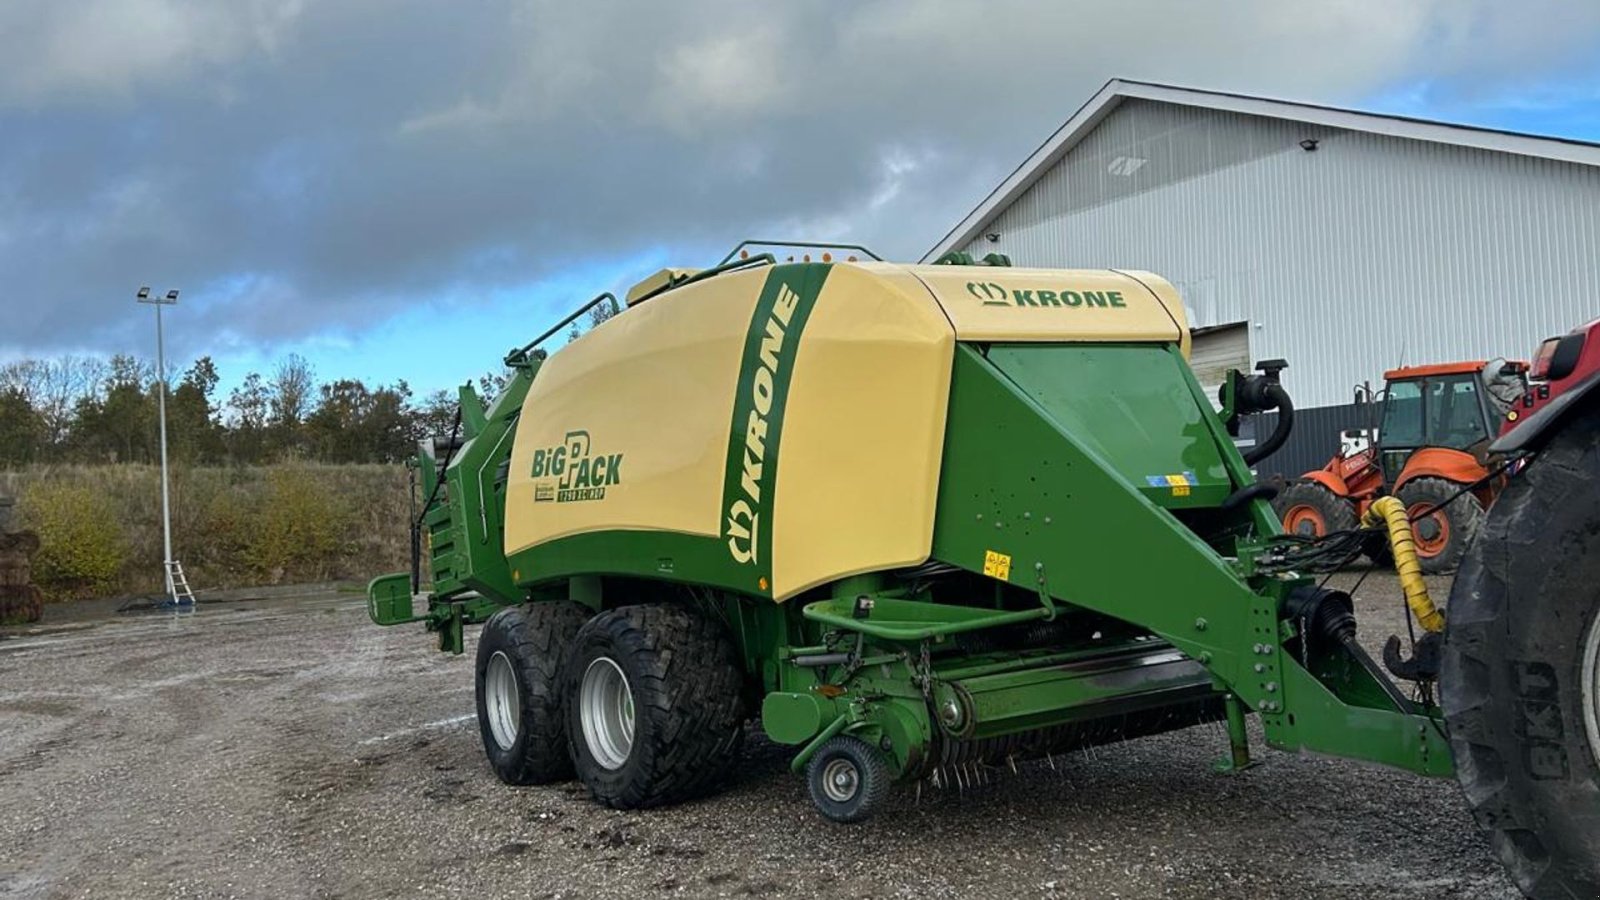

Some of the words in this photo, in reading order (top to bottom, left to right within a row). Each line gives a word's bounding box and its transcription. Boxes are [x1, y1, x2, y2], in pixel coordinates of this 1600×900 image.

[1012, 290, 1127, 308] KRONE
[741, 282, 799, 503] KRONE
[1517, 661, 1564, 779] BKT
